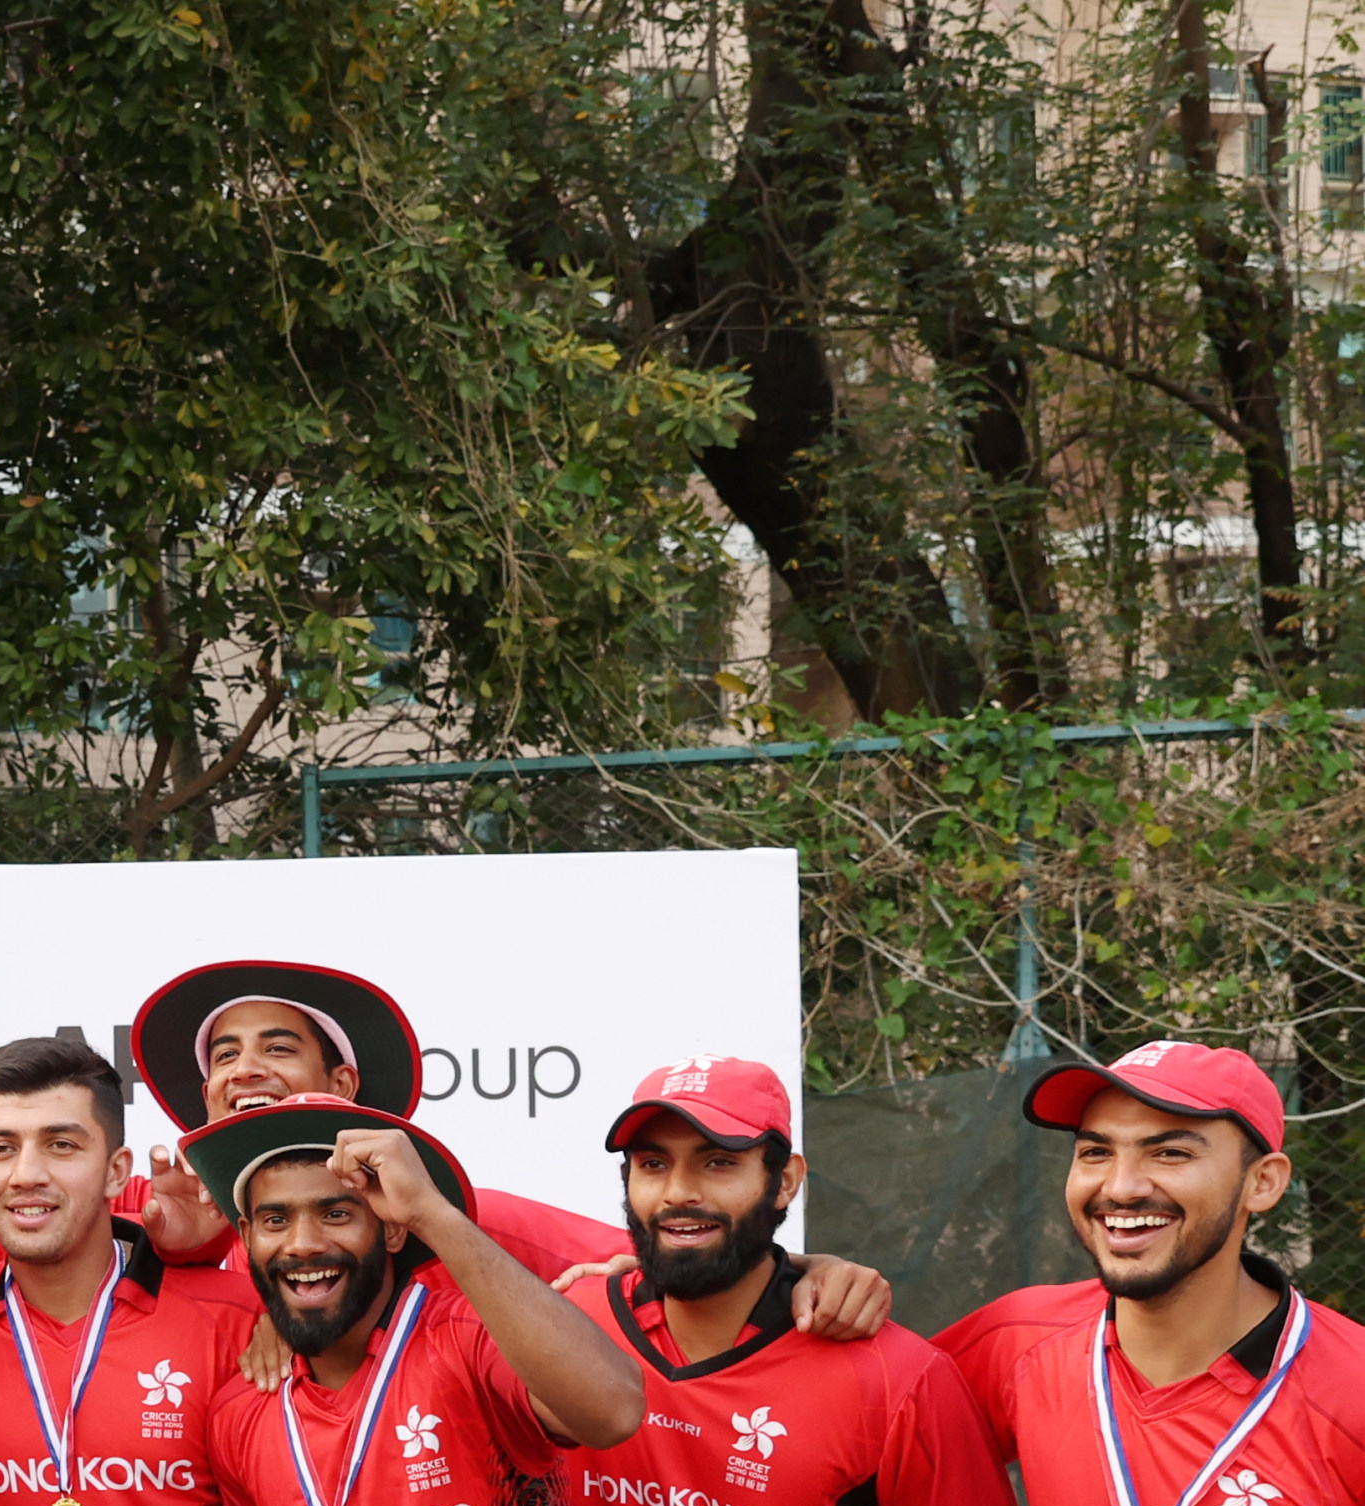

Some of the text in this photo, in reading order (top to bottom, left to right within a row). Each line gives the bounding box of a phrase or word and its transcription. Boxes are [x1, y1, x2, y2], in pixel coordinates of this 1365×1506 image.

[420, 1044, 581, 1118] oup
[142, 1411, 184, 1422] CRICKET
[77, 1456, 196, 1492] KONG
[406, 1457, 447, 1475] CRICKET
[726, 1465, 769, 1482] HONG KONG
[727, 1456, 771, 1475] CRICKET
